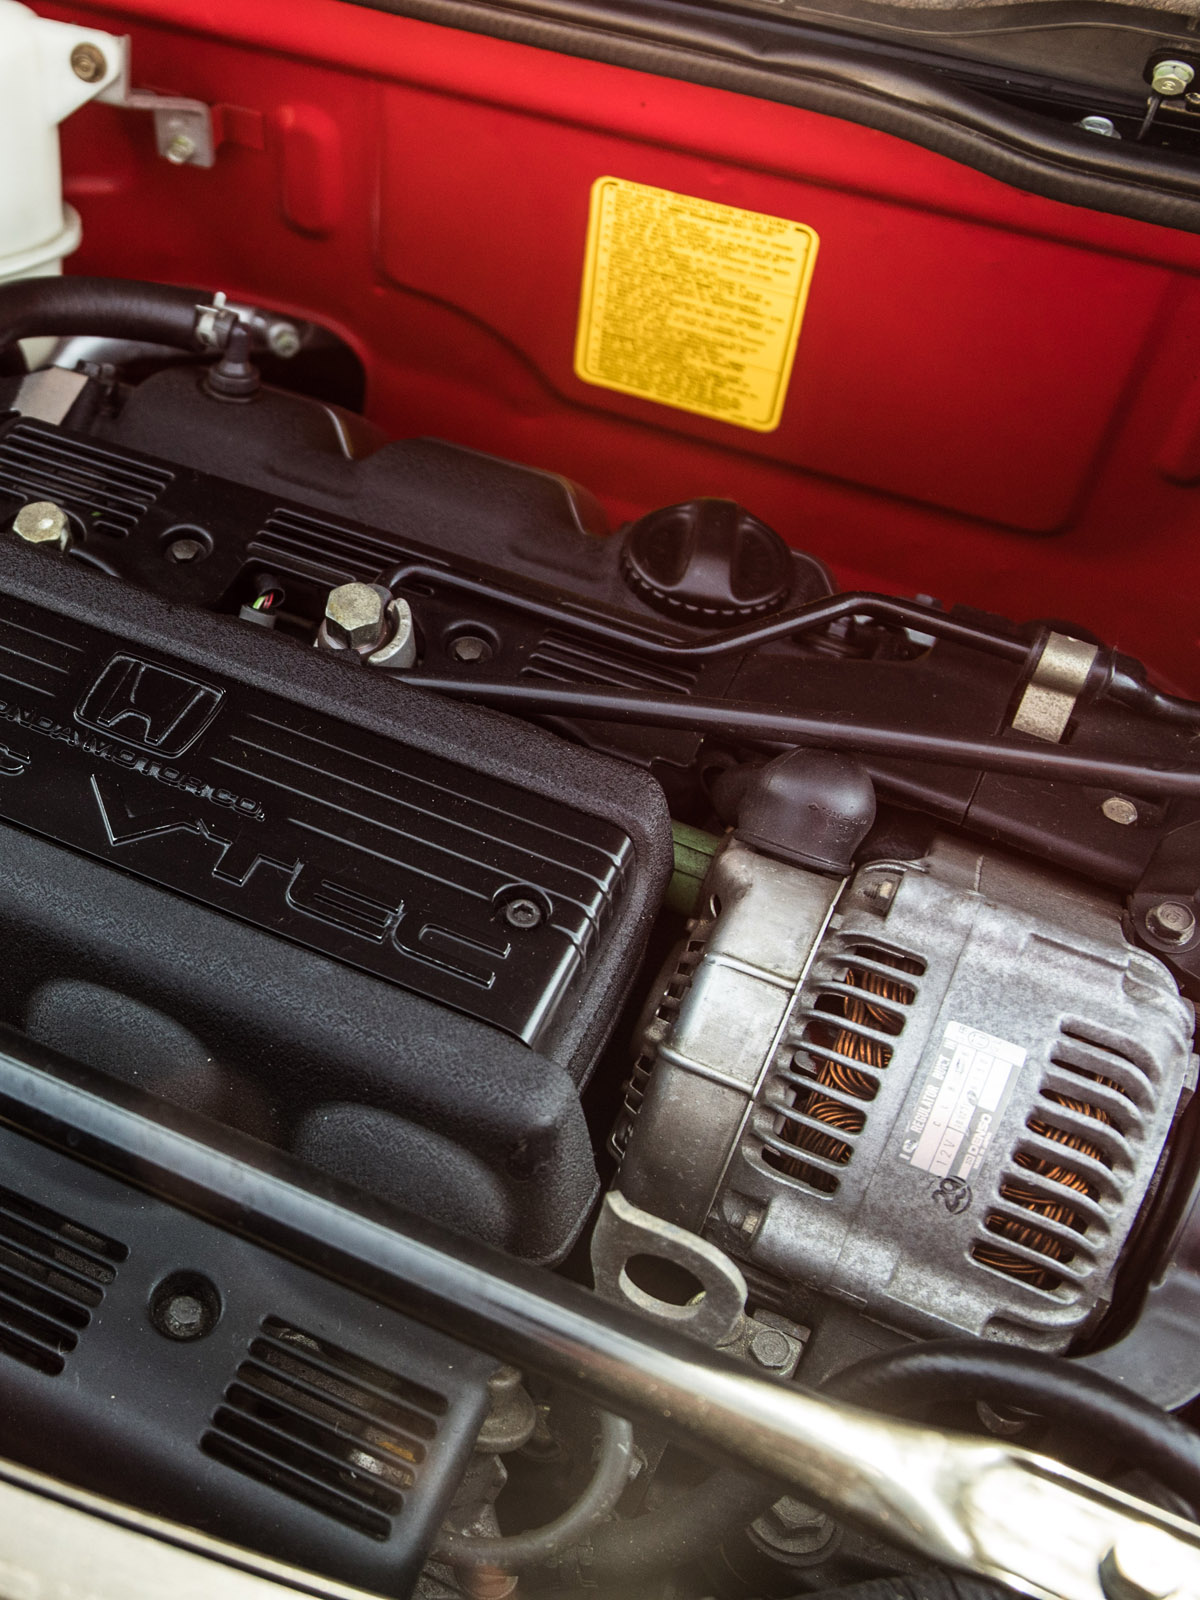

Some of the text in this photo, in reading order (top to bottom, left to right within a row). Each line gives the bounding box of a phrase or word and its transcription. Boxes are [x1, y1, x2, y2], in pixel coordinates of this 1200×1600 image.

[82, 732, 206, 798] MOTOR
[91, 774, 512, 990] VTEC
[910, 1084, 939, 1134] REGULATOR
[968, 1113, 992, 1156] DENSO
